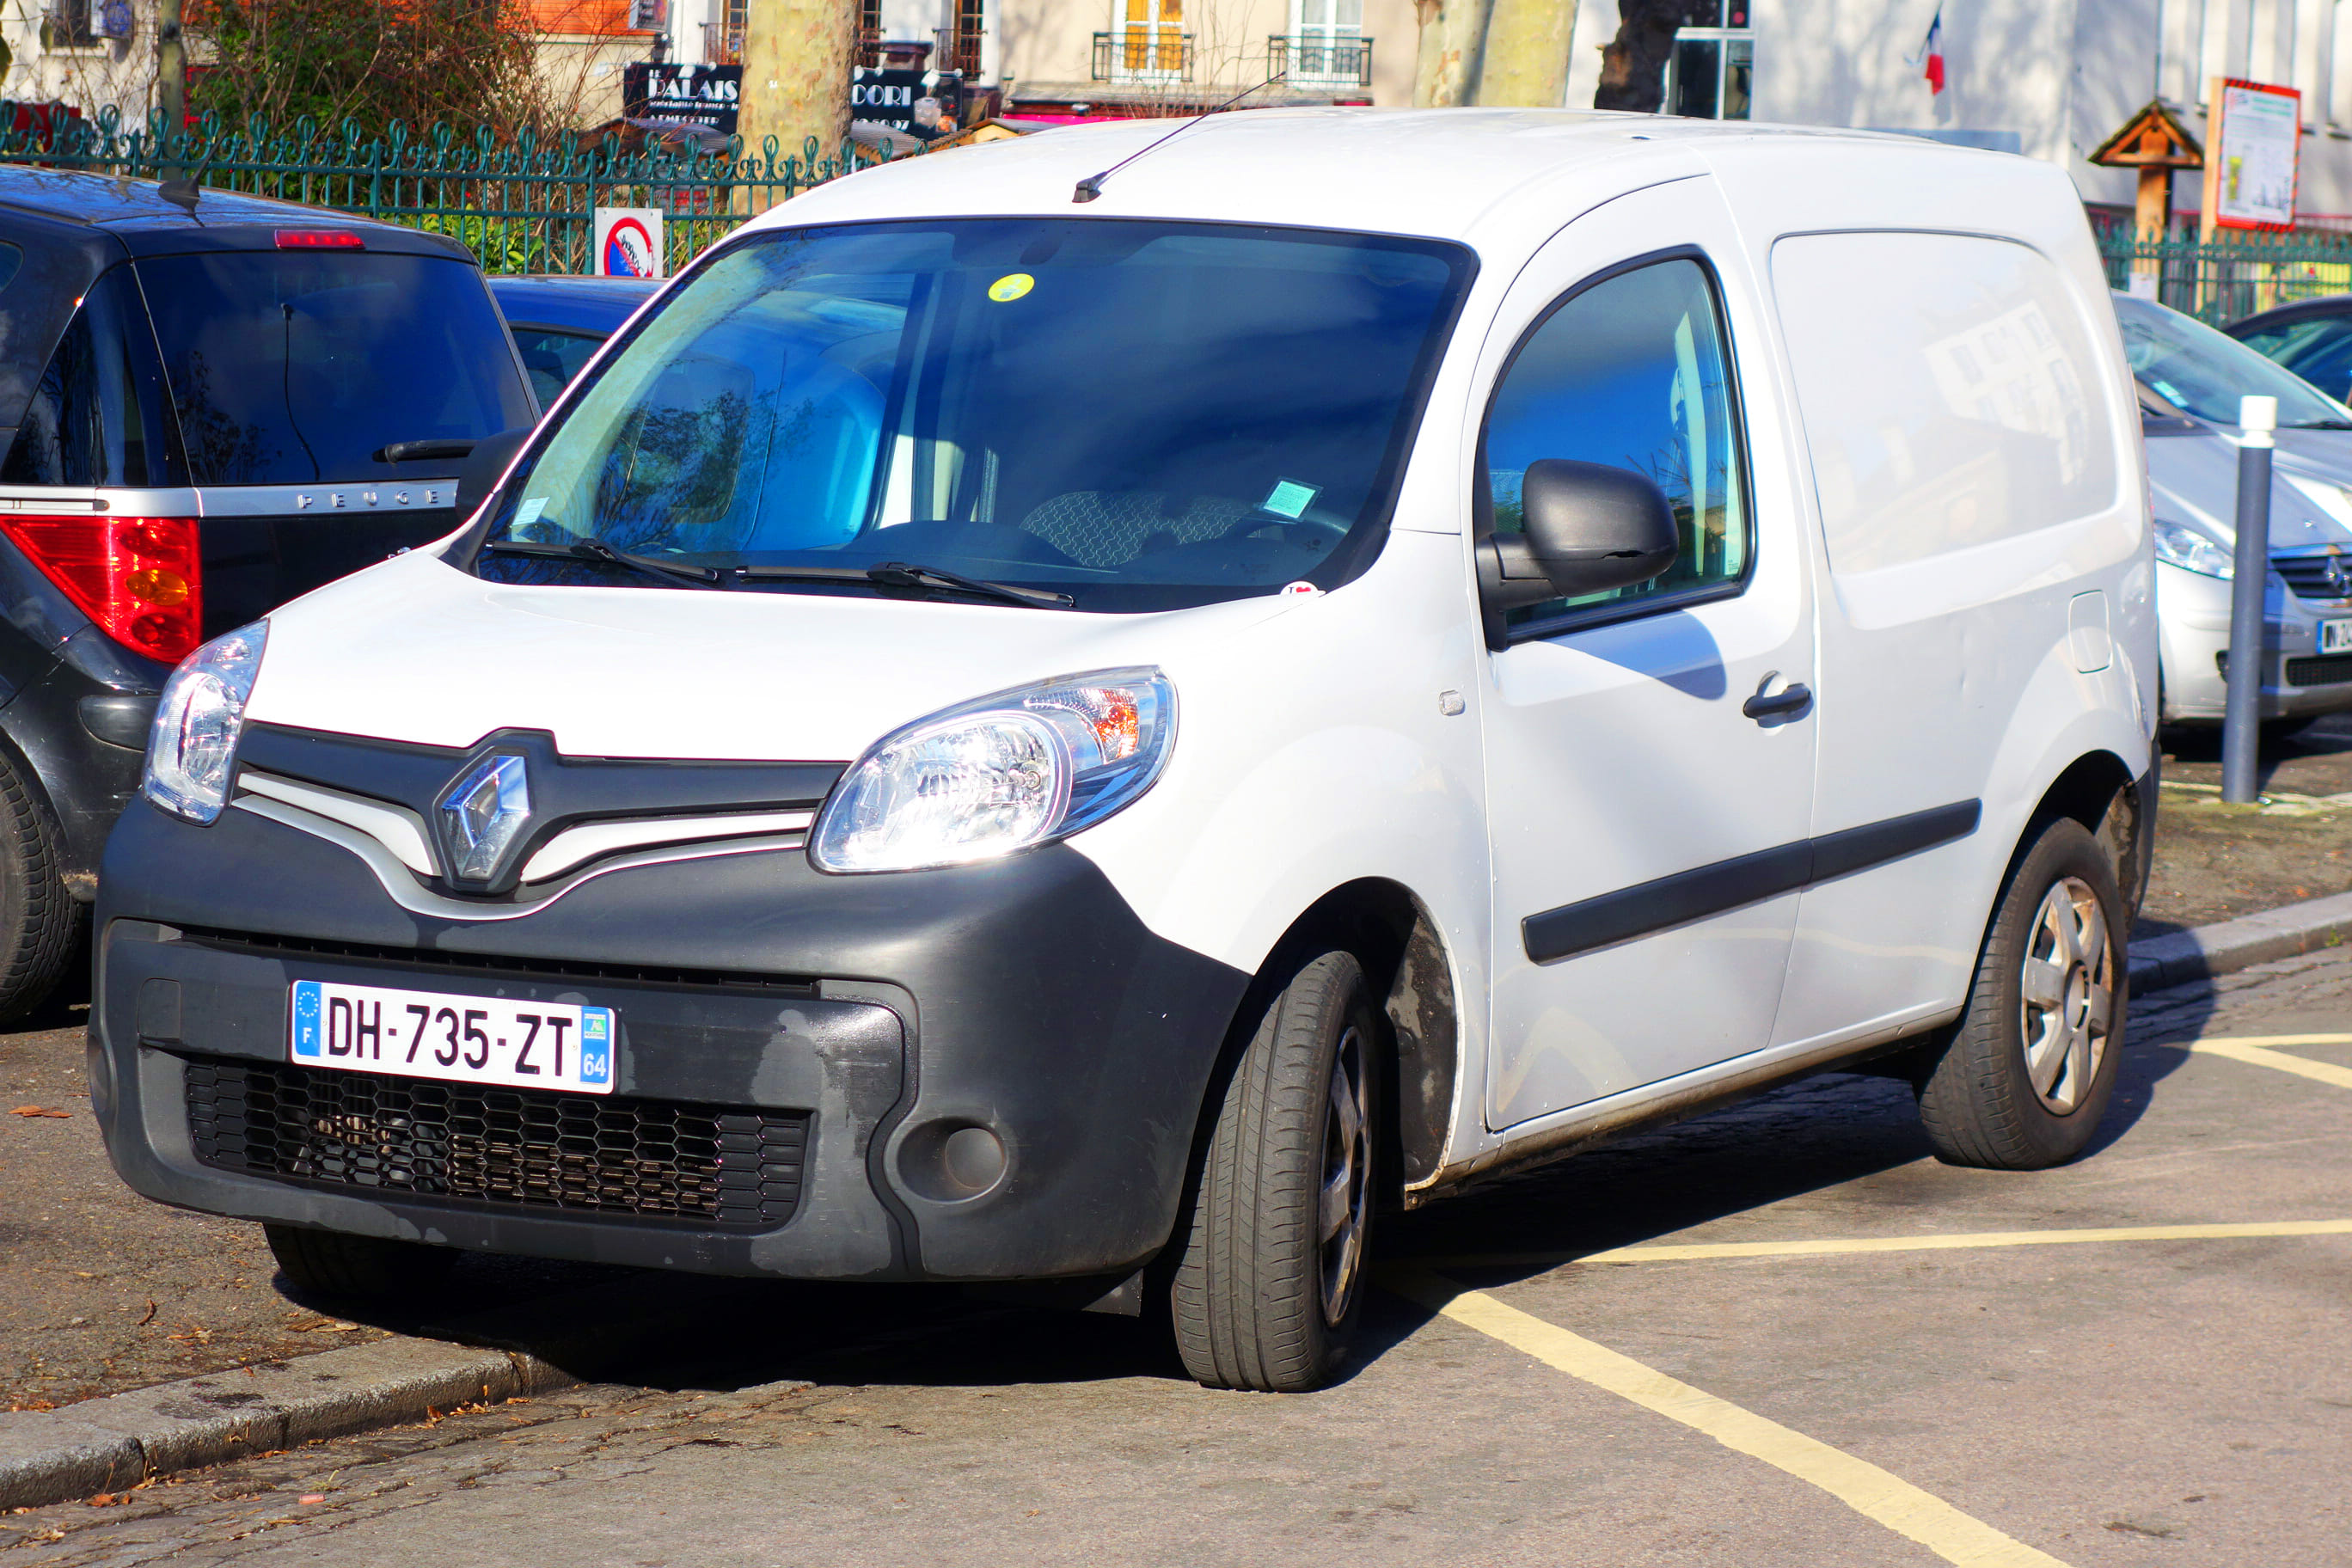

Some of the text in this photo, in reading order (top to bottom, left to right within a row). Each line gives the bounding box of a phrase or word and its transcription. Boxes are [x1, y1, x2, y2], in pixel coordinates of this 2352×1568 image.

[648, 77, 738, 101] PALAIS
[303, 1027, 312, 1044] F
[328, 996, 573, 1077] DH-735-ZT
[583, 1052, 607, 1077] 64
